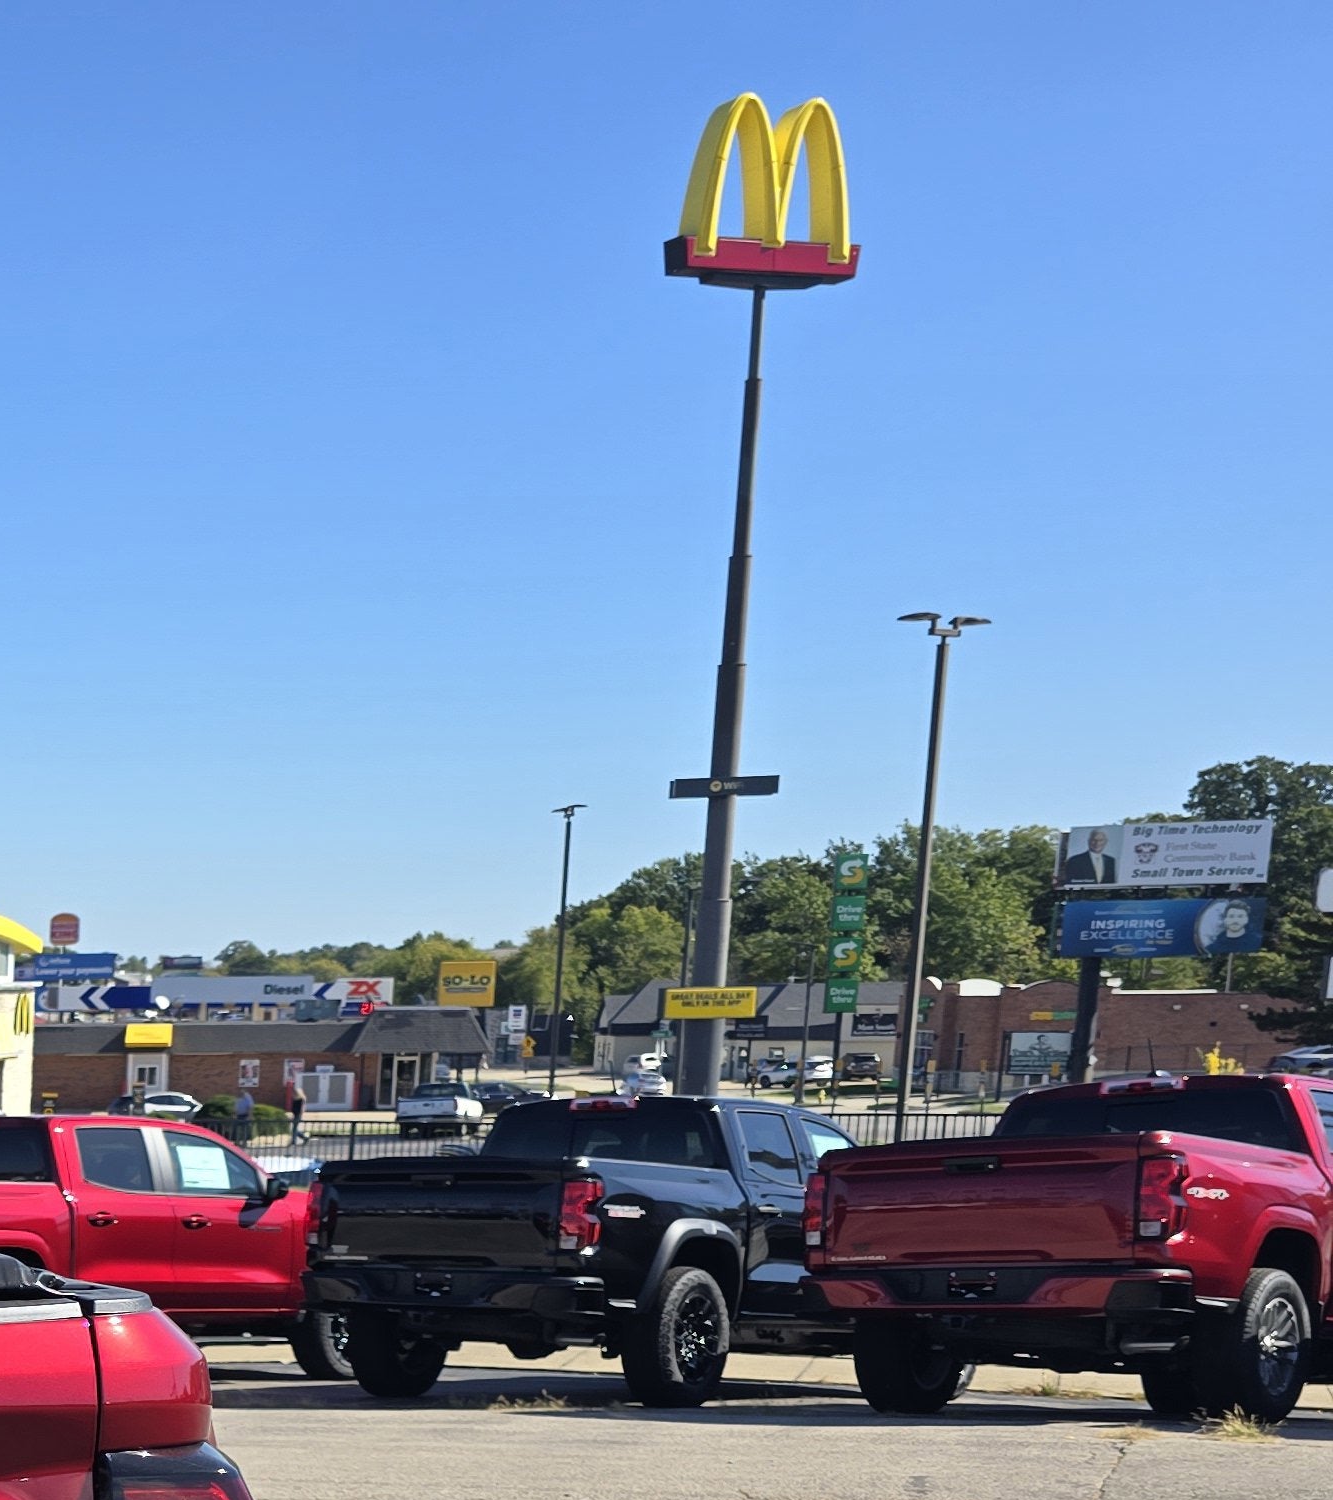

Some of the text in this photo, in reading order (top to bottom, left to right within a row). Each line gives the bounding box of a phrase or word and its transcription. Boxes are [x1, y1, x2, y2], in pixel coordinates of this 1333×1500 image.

[1132, 822, 1263, 838] Big Time Technology
[1165, 841, 1218, 851] First State
[1163, 851, 1257, 864] Community Bank
[1132, 865, 1255, 879] Small Town Service
[836, 905, 863, 914] Drive
[838, 914, 860, 922] thru
[1090, 918, 1166, 930] INSPIRING
[1079, 929, 1174, 941] EXCELLENCE
[442, 975, 491, 987] SO-LO
[263, 983, 305, 995] Diesel
[347, 980, 382, 996] ZX
[829, 987, 856, 996] Drive
[832, 995, 853, 1004] thru
